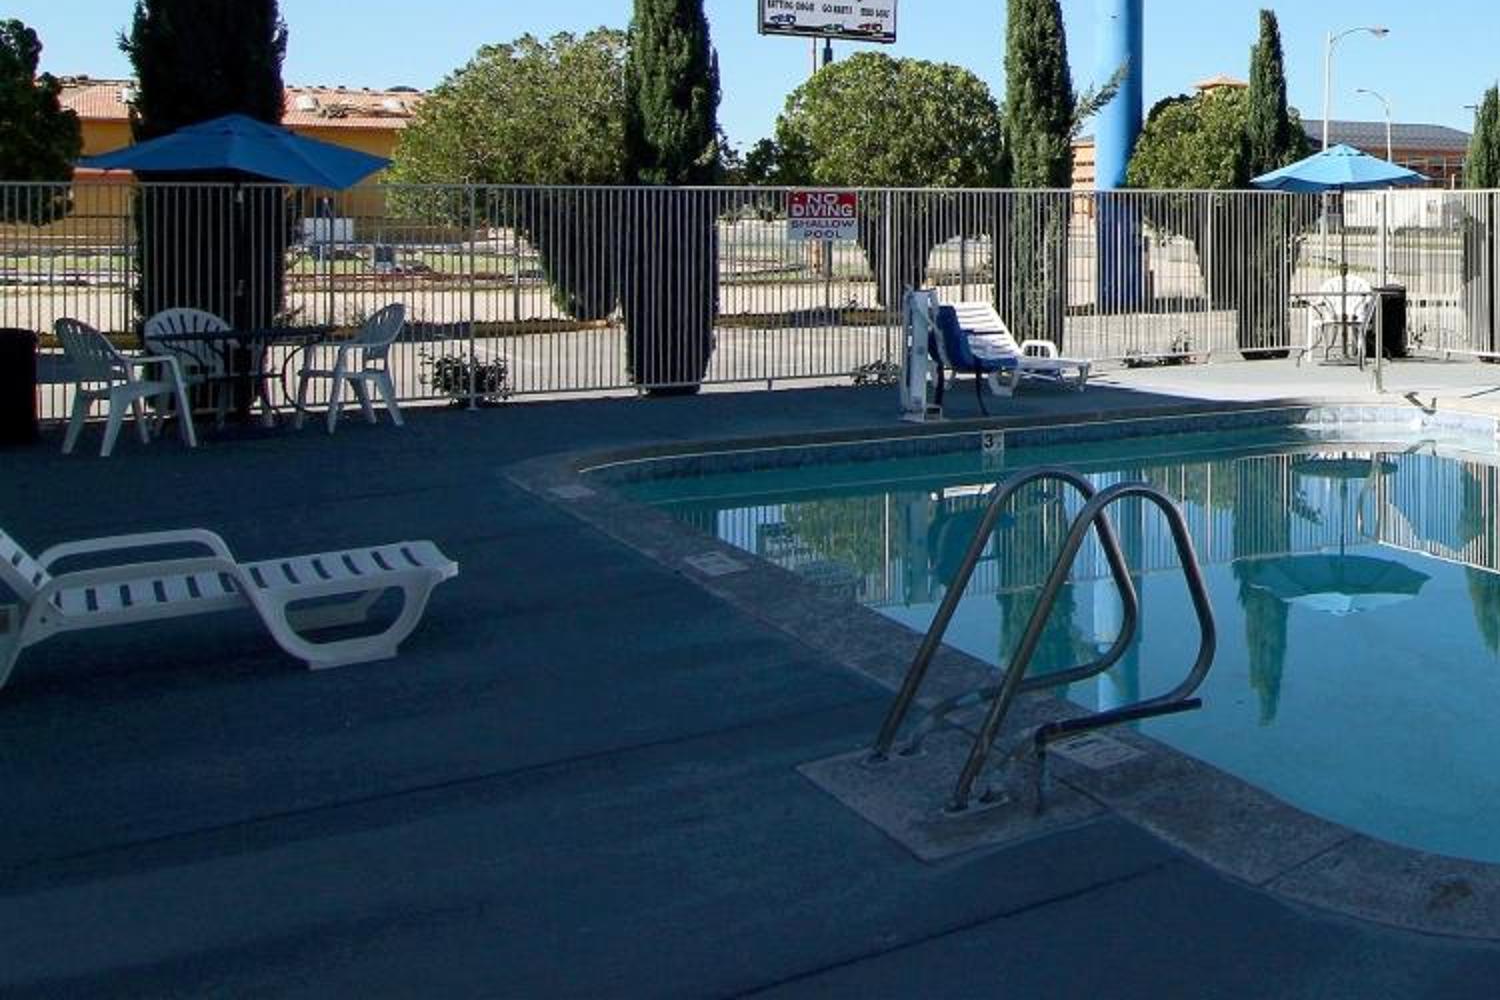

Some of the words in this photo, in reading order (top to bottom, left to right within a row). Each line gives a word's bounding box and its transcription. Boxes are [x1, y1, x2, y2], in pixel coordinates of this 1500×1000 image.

[806, 193, 838, 204] NO
[791, 203, 854, 217] DIVING
[791, 219, 855, 228] SHALLOW
[803, 229, 843, 239] POOL
[983, 433, 994, 449] 3
